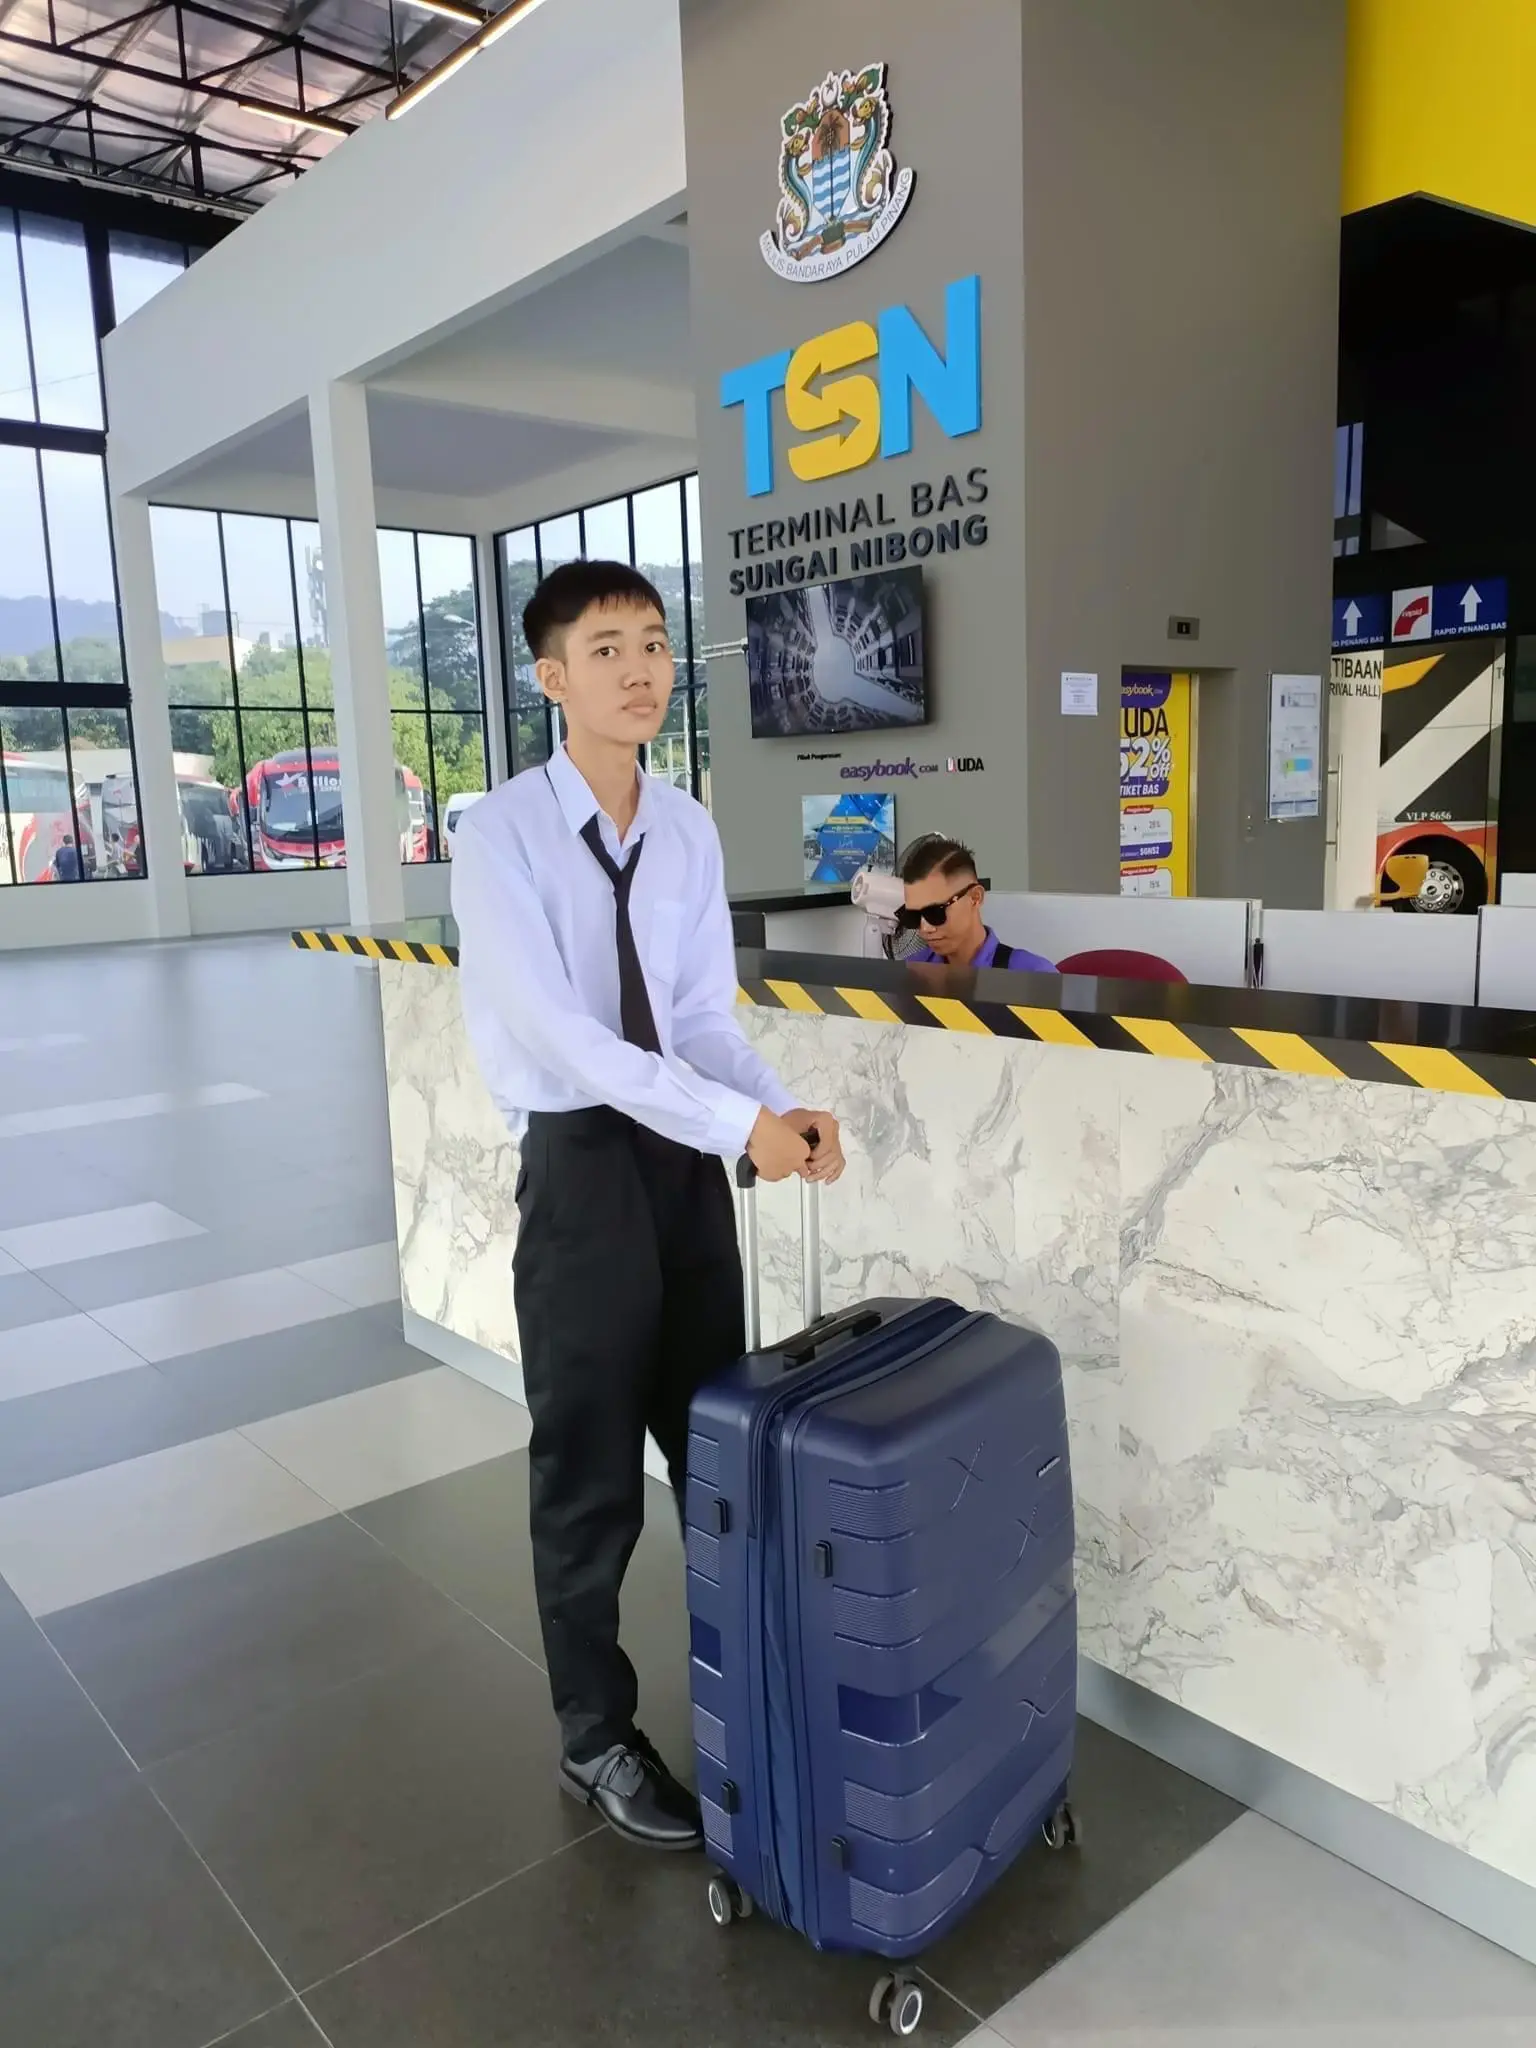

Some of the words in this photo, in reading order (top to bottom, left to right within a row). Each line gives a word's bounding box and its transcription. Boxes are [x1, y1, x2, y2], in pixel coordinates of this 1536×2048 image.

[786, 257, 843, 279] BANDARAYA
[846, 232, 881, 263] PULAU
[881, 171, 911, 234] PINANG
[720, 273, 981, 497] TSN
[728, 493, 896, 560] TERMINAL
[910, 467, 989, 518] BAS
[729, 546, 838, 597] SUNGAI
[849, 514, 989, 573] NIBONG
[1434, 627, 1457, 637] RAPID
[1458, 624, 1490, 634] PENANG
[1490, 622, 1508, 631] BAS
[1124, 707, 1169, 738] UDA
[840, 757, 918, 782] easybook
[957, 757, 985, 773] UDA
[1142, 784, 1160, 796] BAS
[1406, 811, 1428, 821] VLP
[1430, 810, 1452, 821] 5656
